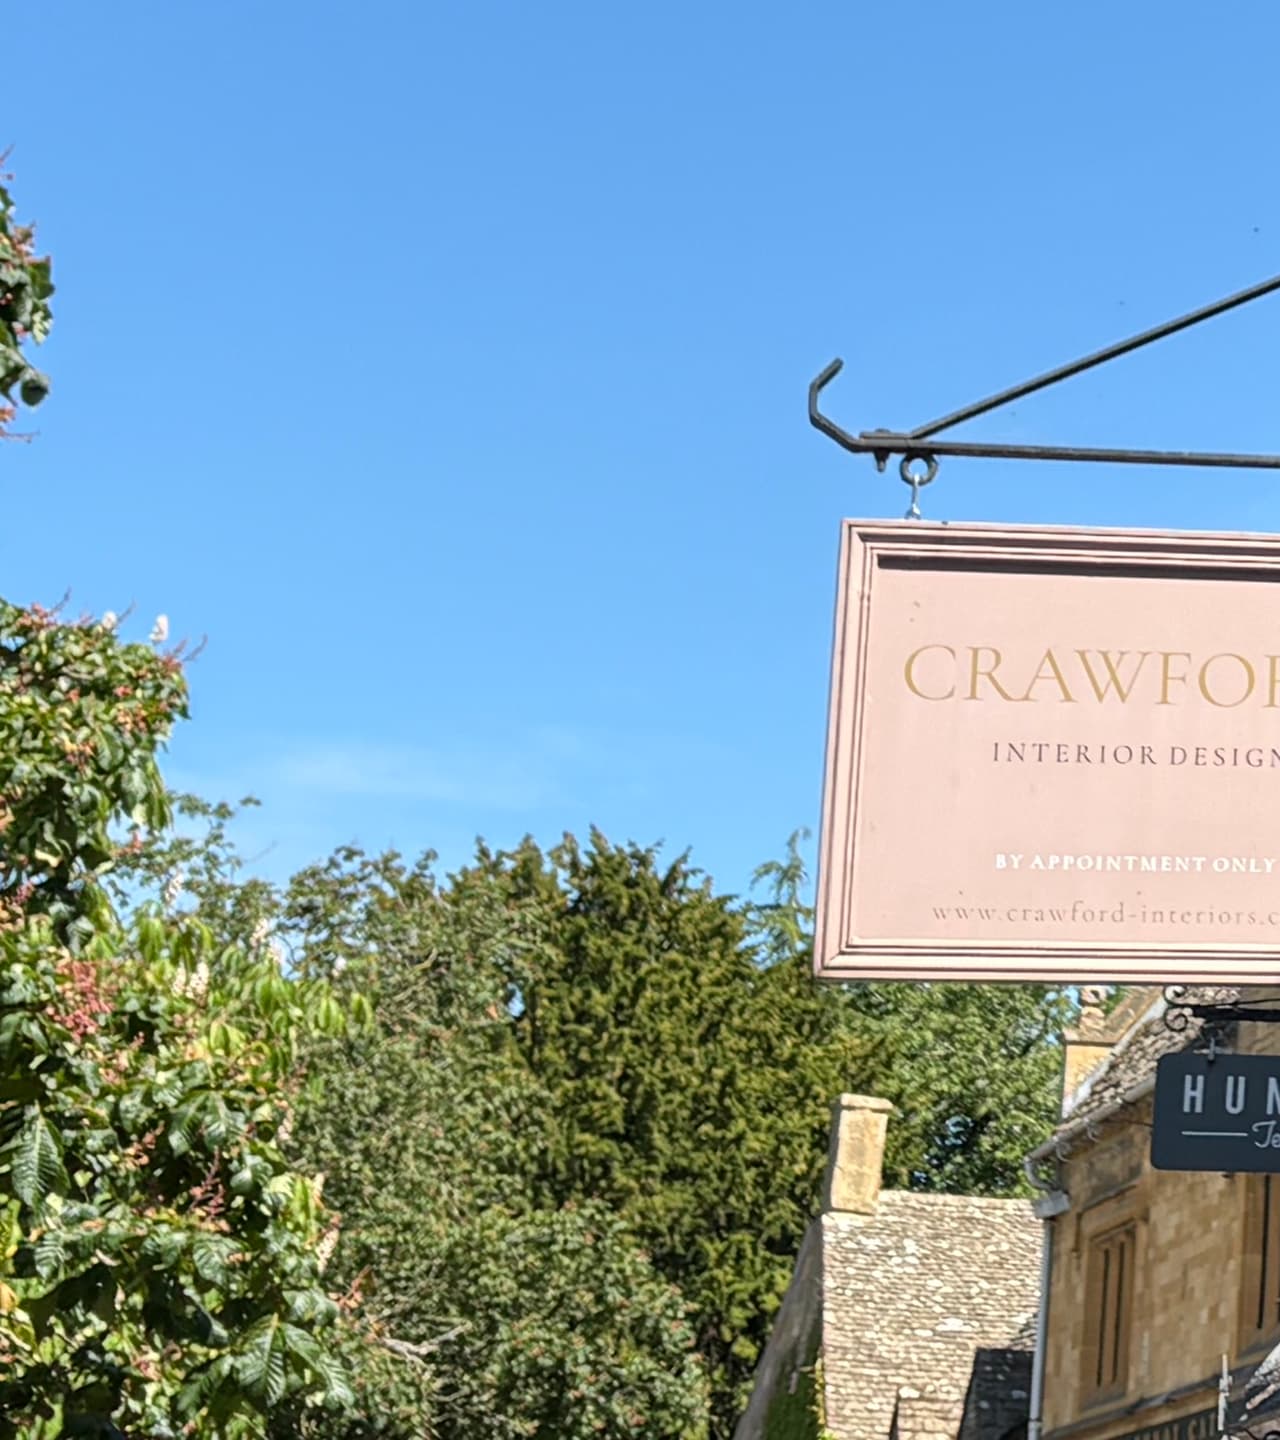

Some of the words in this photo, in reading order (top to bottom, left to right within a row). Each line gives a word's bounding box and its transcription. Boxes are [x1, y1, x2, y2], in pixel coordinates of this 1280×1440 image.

[993, 741, 1158, 766] INTERIOR
[995, 853, 1025, 870] BY
[1029, 854, 1207, 873] APPOINTMENT
[1212, 857, 1278, 873] ONLY
